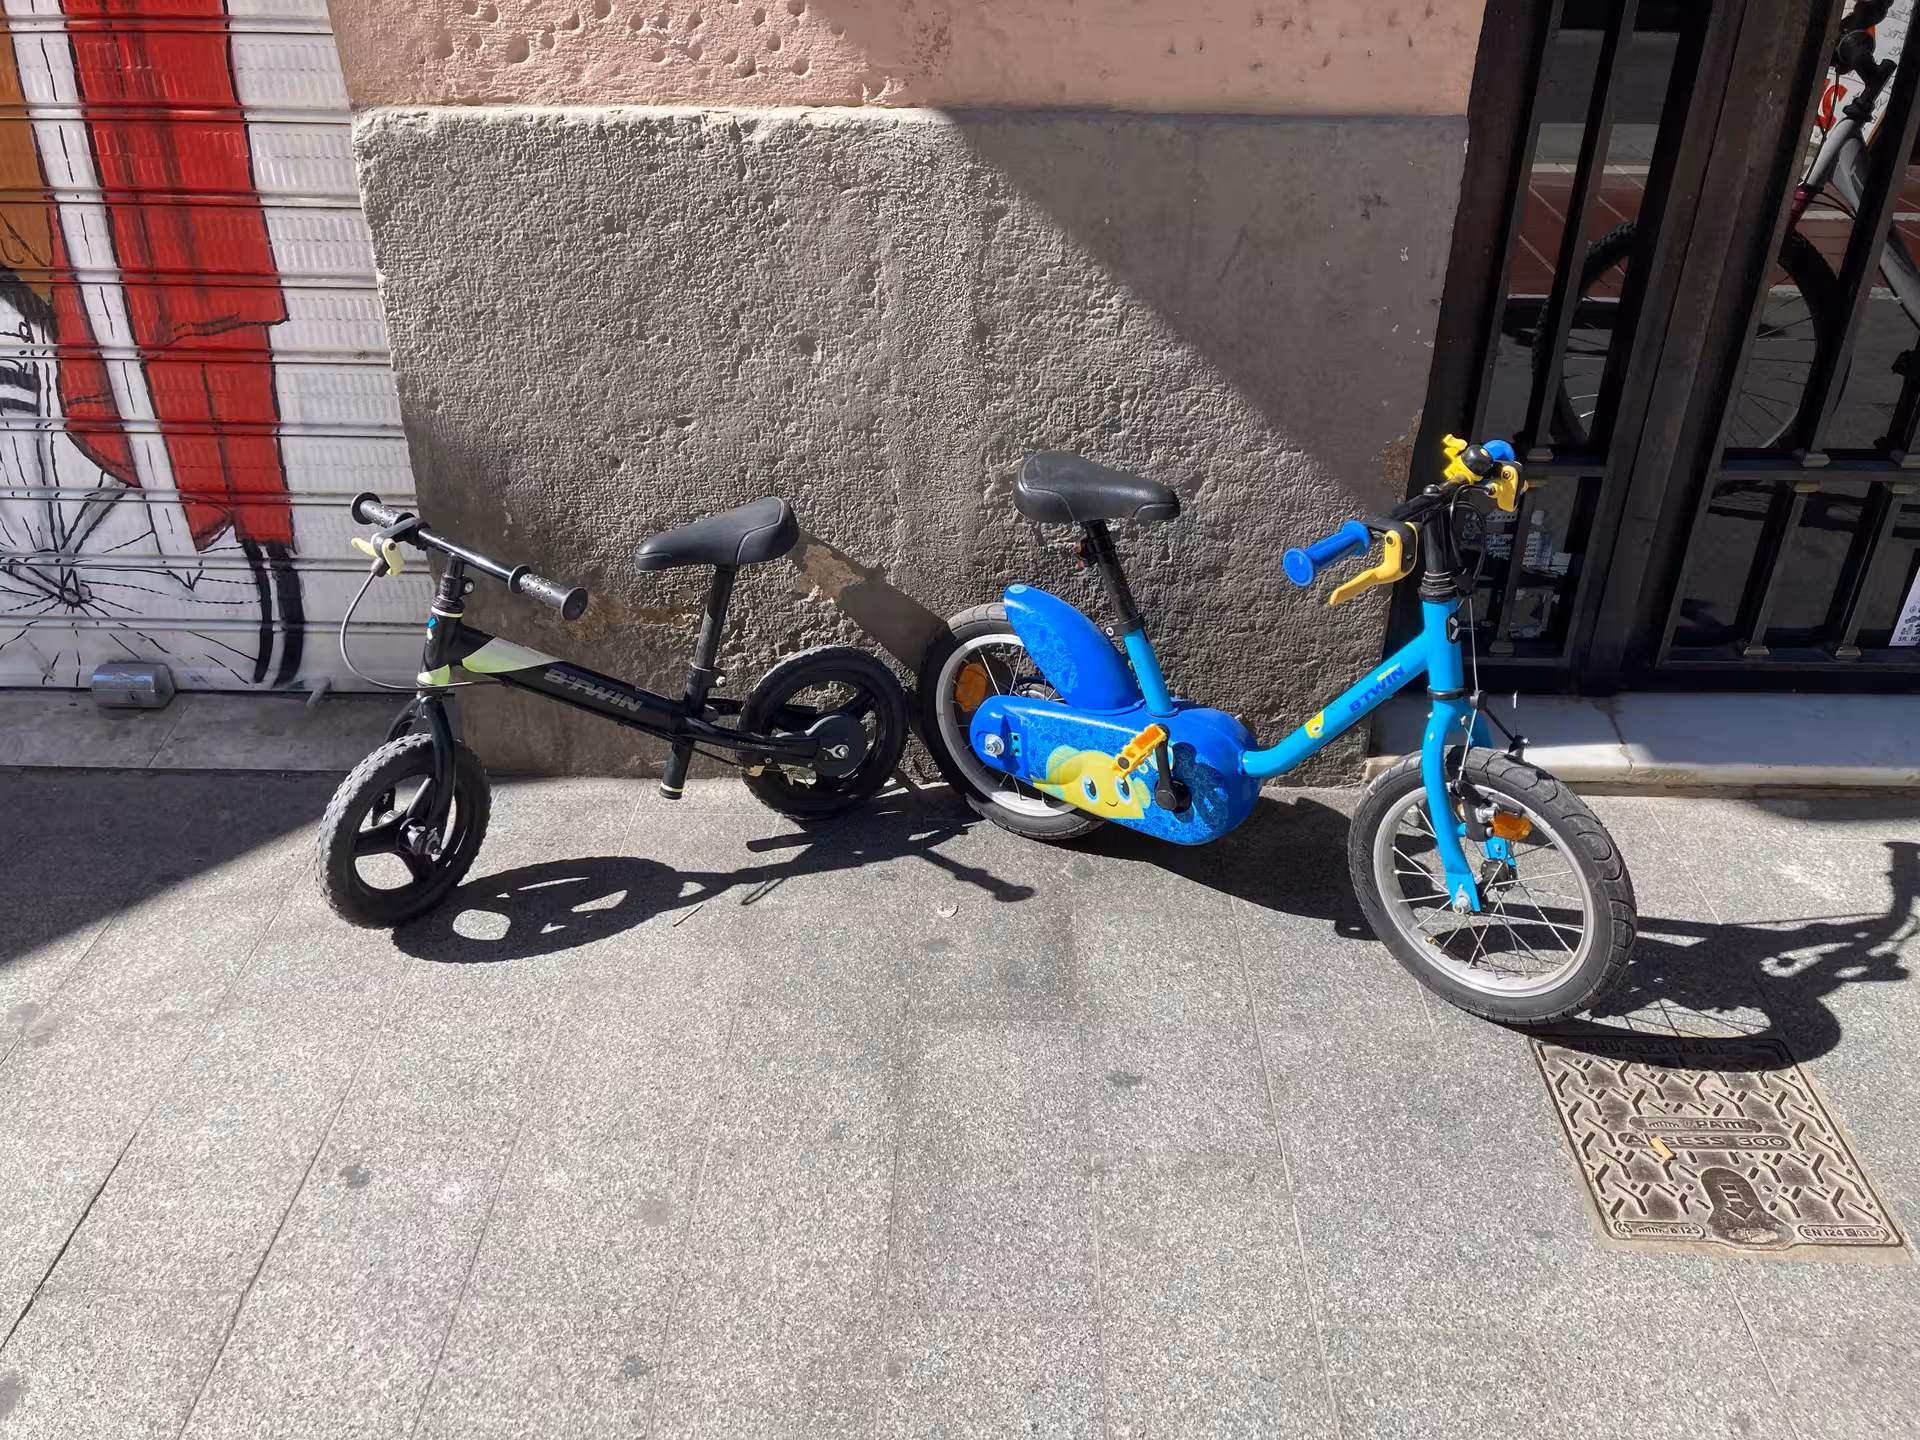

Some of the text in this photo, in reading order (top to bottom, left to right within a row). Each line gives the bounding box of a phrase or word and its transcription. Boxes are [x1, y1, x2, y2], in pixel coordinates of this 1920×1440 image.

[1737, 1136, 1786, 1147] 300
[1680, 1226, 1701, 1235] 125
[1803, 1228, 1822, 1237] EN
